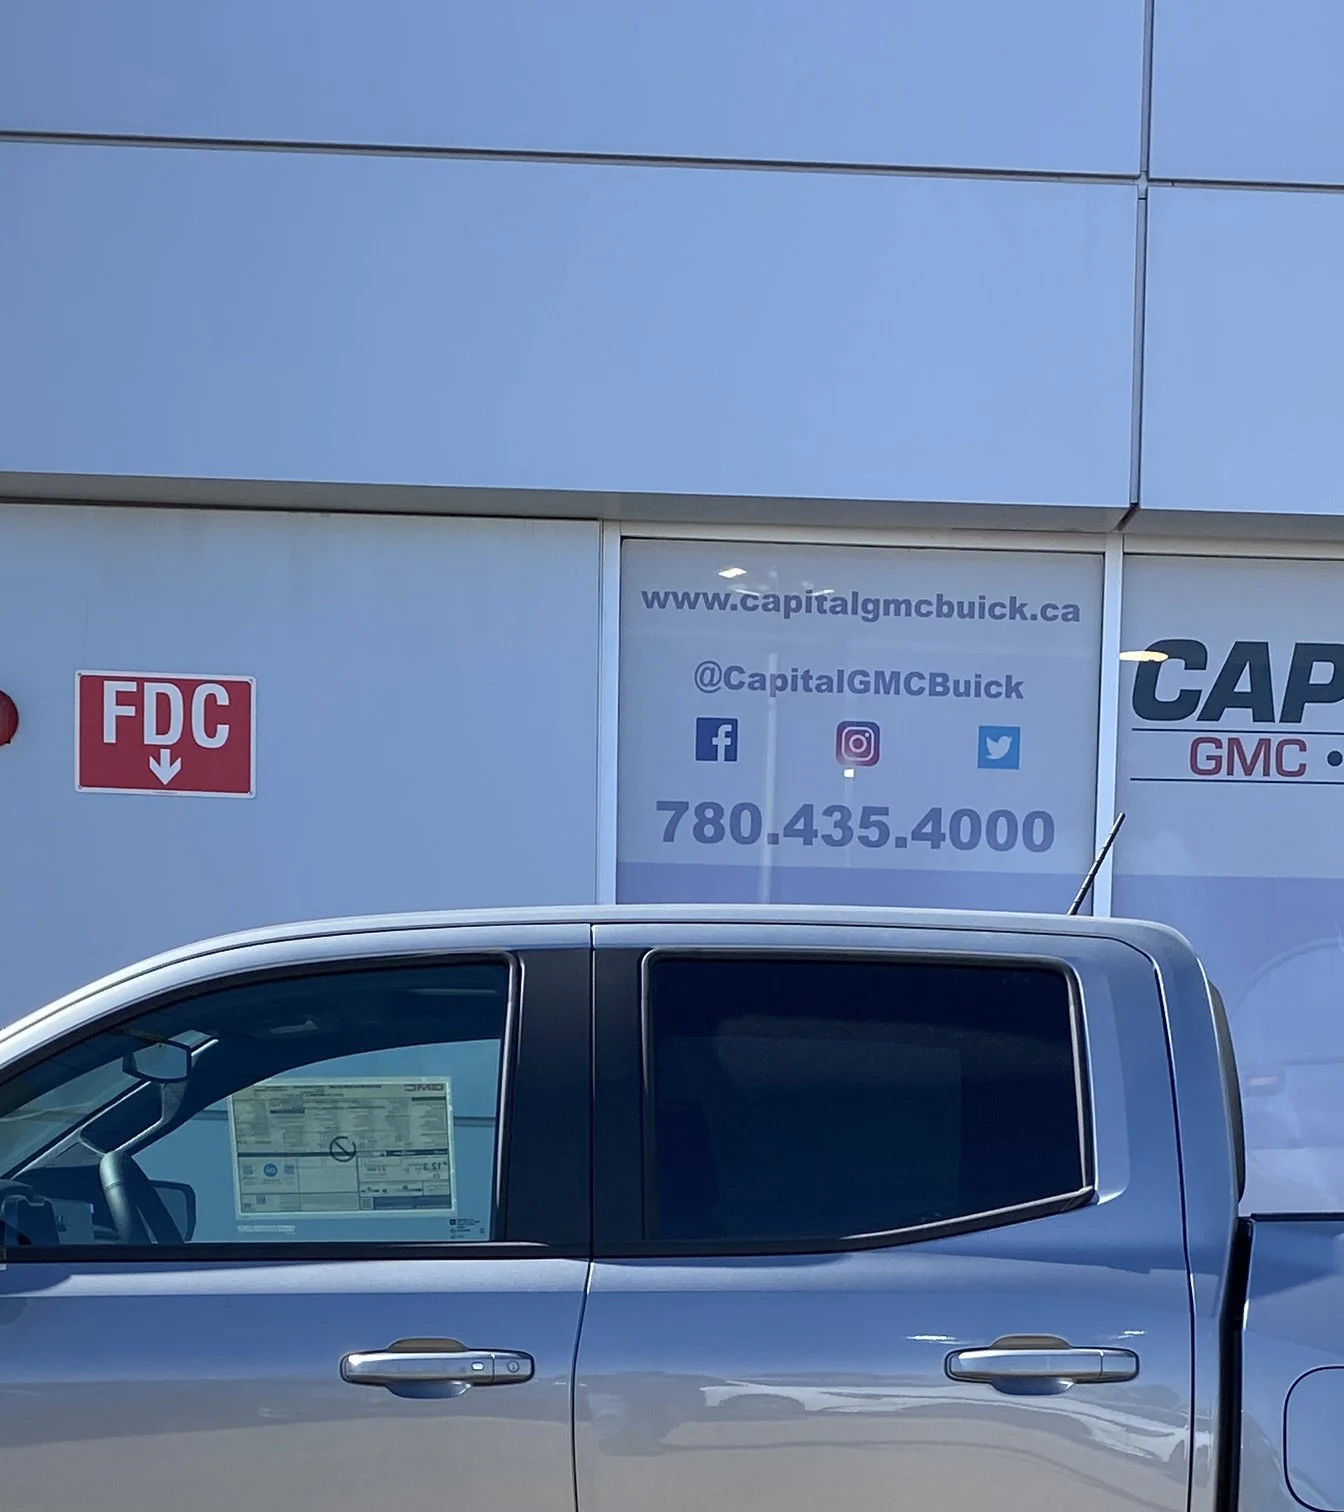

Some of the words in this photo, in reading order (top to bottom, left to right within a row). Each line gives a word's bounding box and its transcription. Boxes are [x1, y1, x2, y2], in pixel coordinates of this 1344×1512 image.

[641, 589, 1081, 623] www.capitalgmcbuick.ca
[694, 660, 1025, 700] @CapitalGMCBuick
[103, 680, 230, 749] FDC
[1190, 736, 1307, 779] GMC
[655, 800, 1055, 852] 780.435.4000
